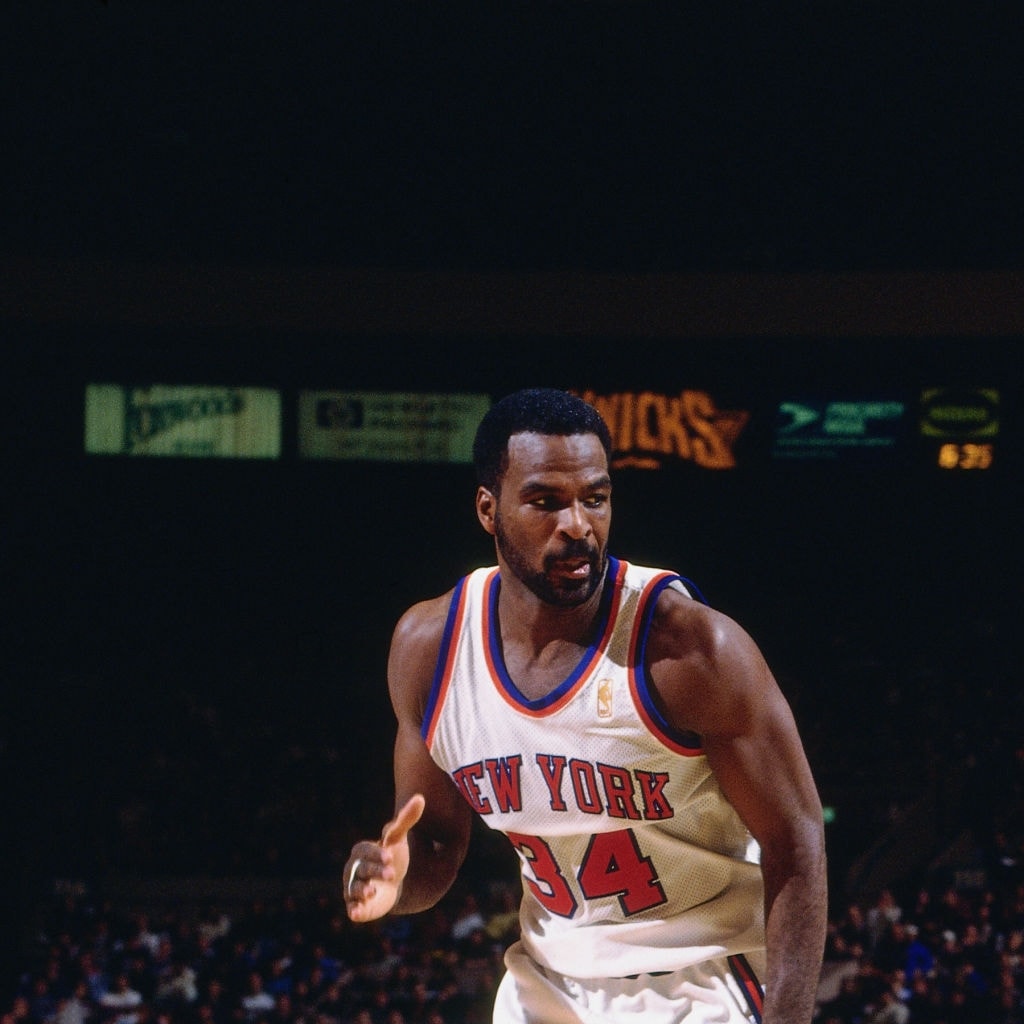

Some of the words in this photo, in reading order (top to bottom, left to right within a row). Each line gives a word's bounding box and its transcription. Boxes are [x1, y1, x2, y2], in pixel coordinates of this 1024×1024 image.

[569, 390, 736, 469] NICKS
[536, 753, 675, 821] YORK
[506, 828, 668, 920] 34
